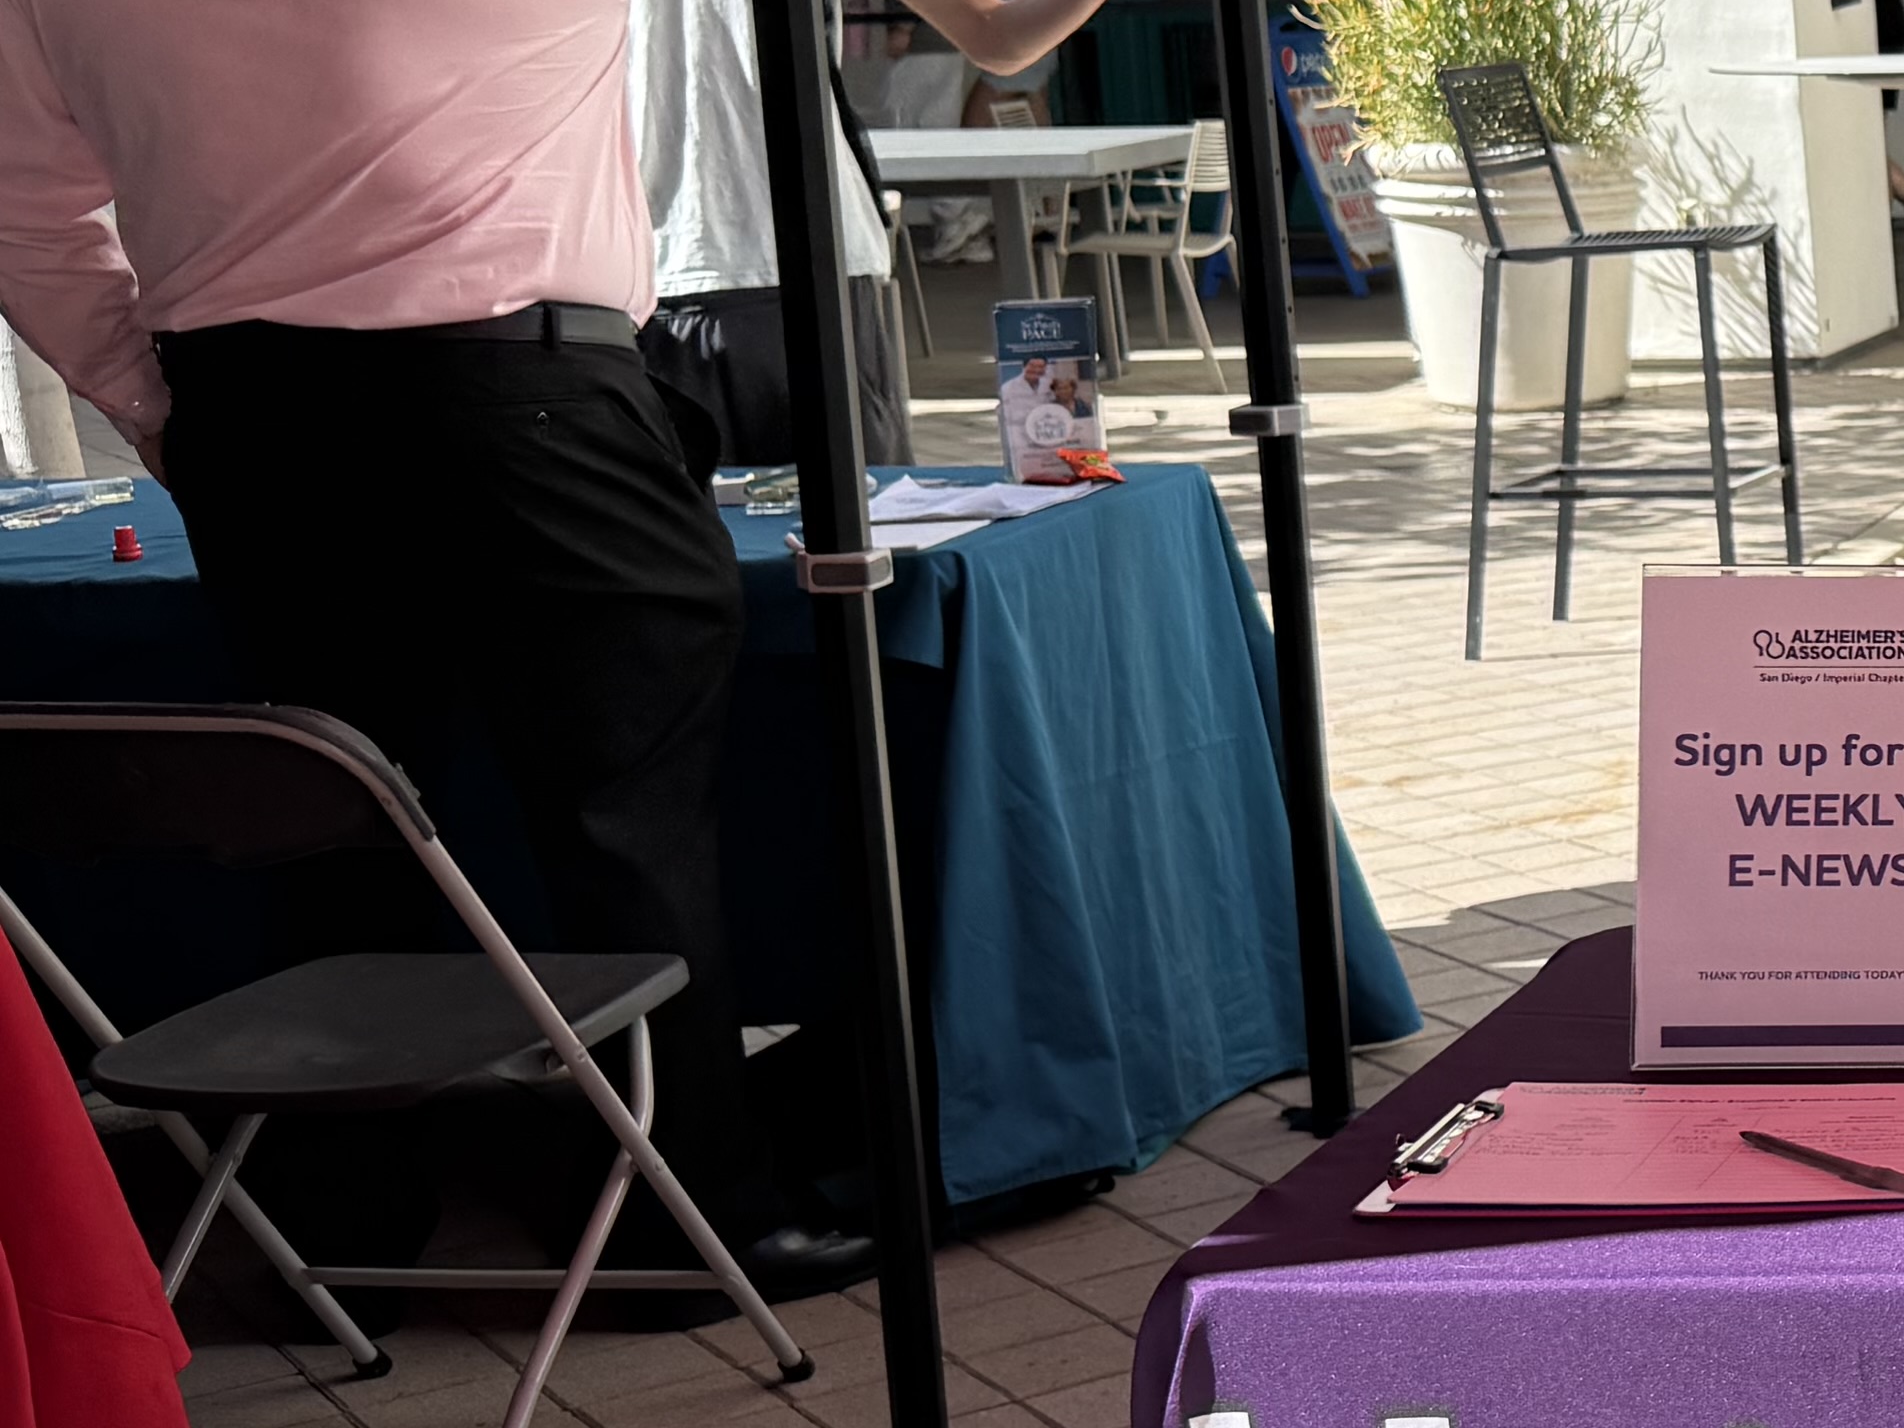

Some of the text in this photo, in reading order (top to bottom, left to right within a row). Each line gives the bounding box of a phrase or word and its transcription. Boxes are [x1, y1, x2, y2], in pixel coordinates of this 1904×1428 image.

[1760, 673, 1778, 682] San
[1782, 674, 1812, 684] Diego
[1824, 673, 1865, 683] Imperial
[1676, 733, 1762, 776] Sign
[1779, 744, 1827, 776] up
[1842, 734, 1904, 766] for
[1699, 972, 1736, 980] THANK
[1740, 972, 1765, 980] YOU
[1768, 971, 1792, 980] FOR
[1796, 971, 1860, 979] ATTENDING
